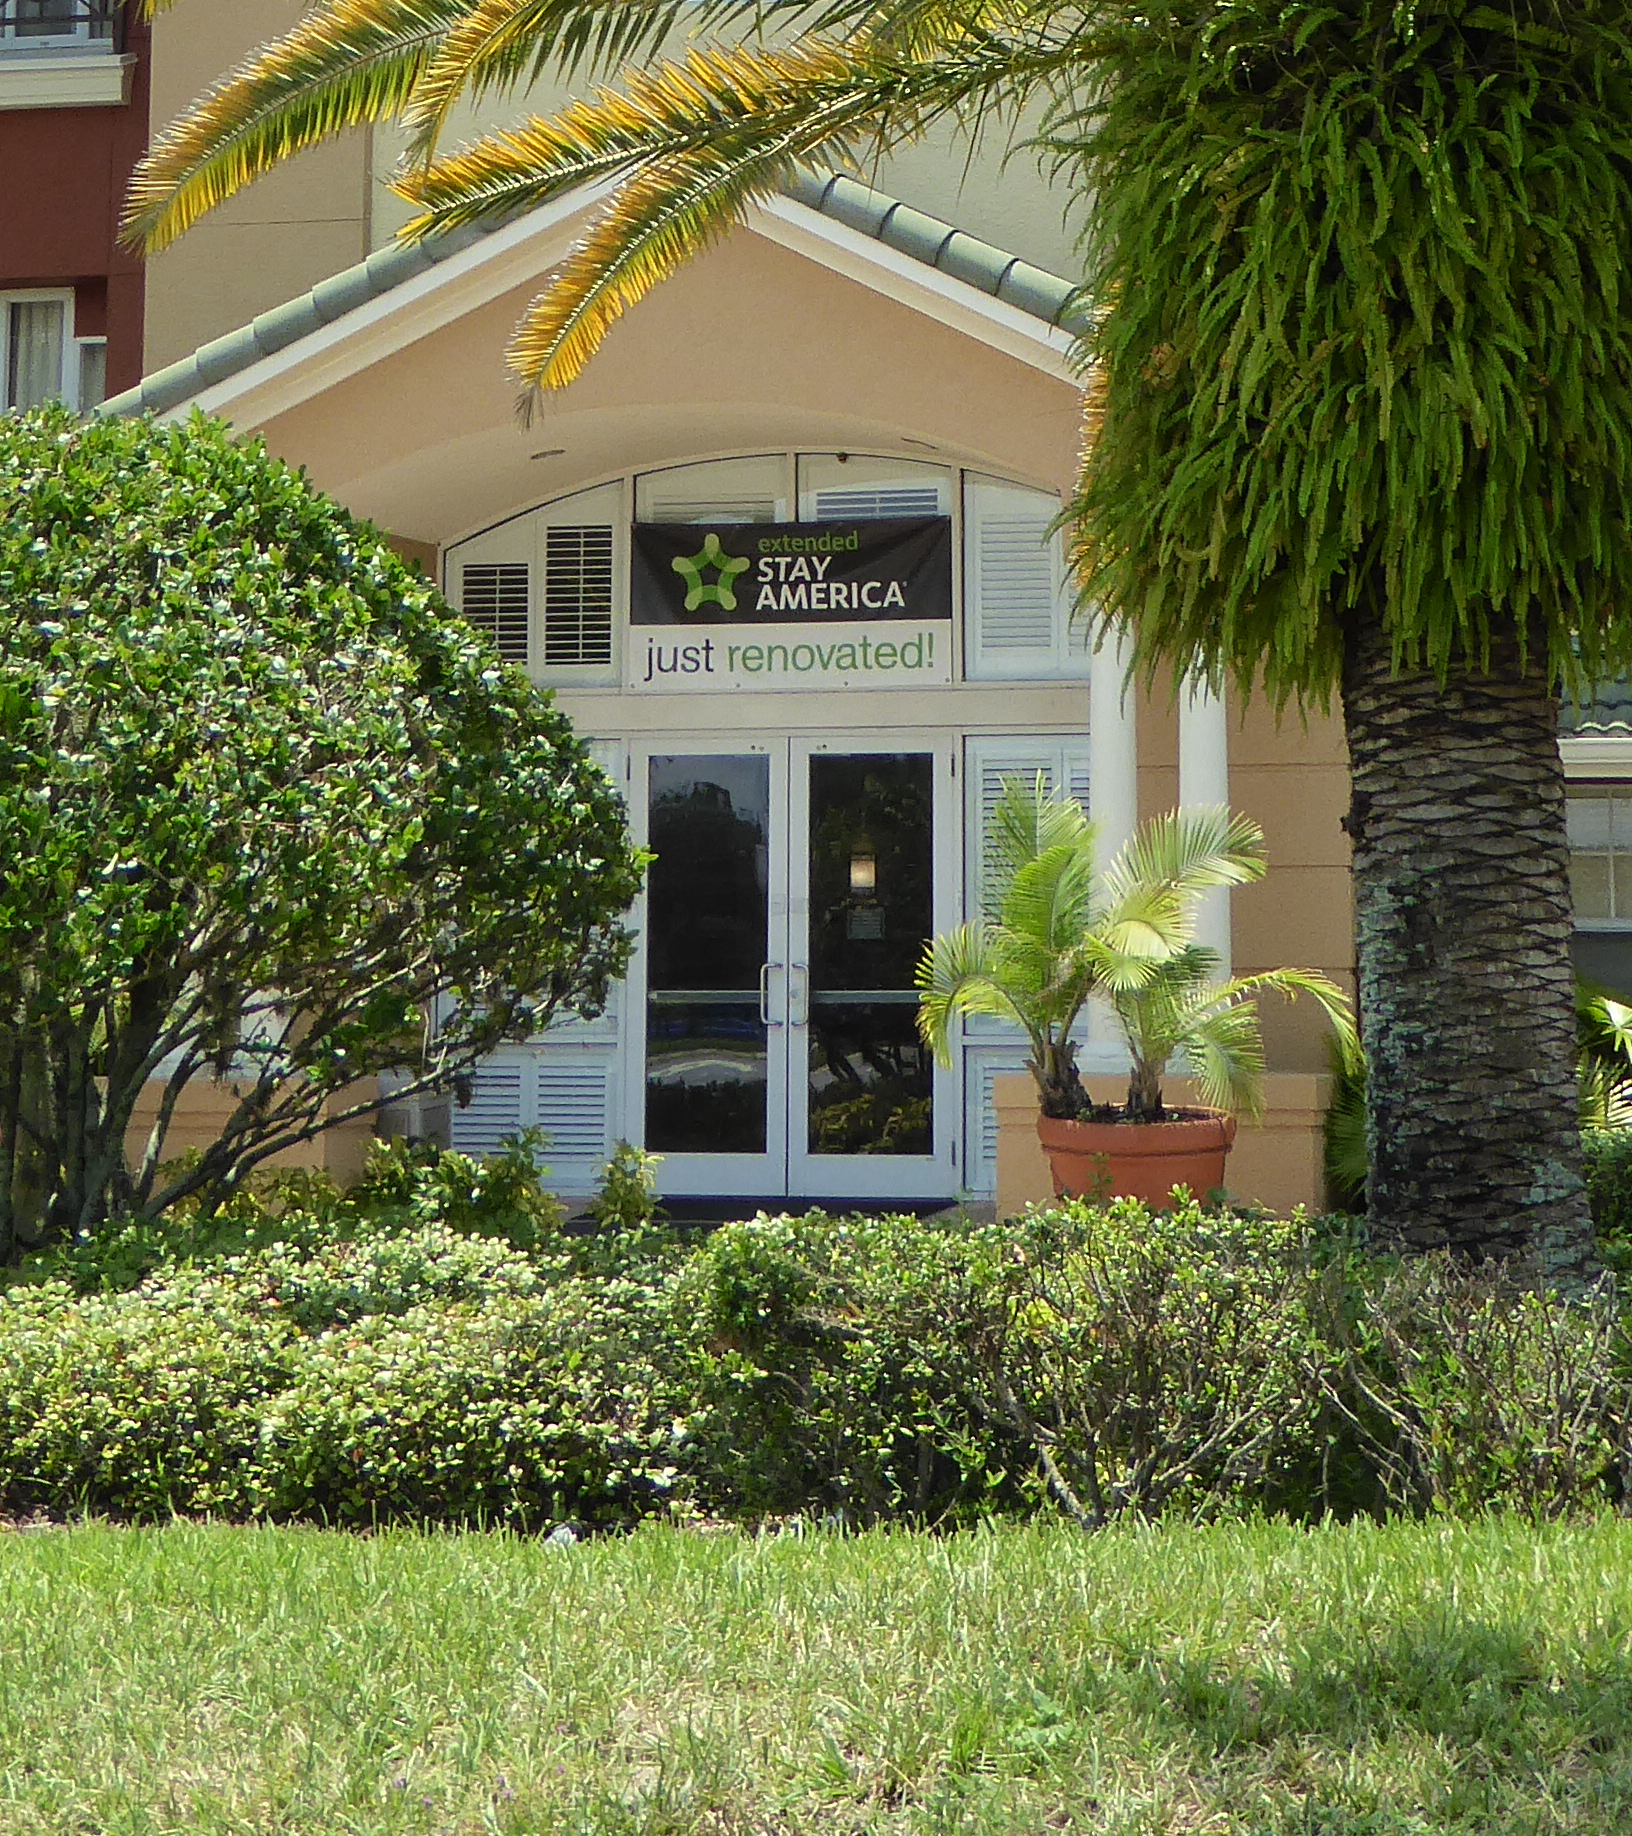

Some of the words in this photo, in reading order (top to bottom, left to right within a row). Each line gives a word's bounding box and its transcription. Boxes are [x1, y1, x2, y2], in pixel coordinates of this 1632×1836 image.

[757, 530, 860, 554] extended
[756, 555, 832, 583] STAY
[755, 581, 907, 611] AMERICA
[643, 637, 715, 682] just
[727, 632, 935, 673] renovated!
